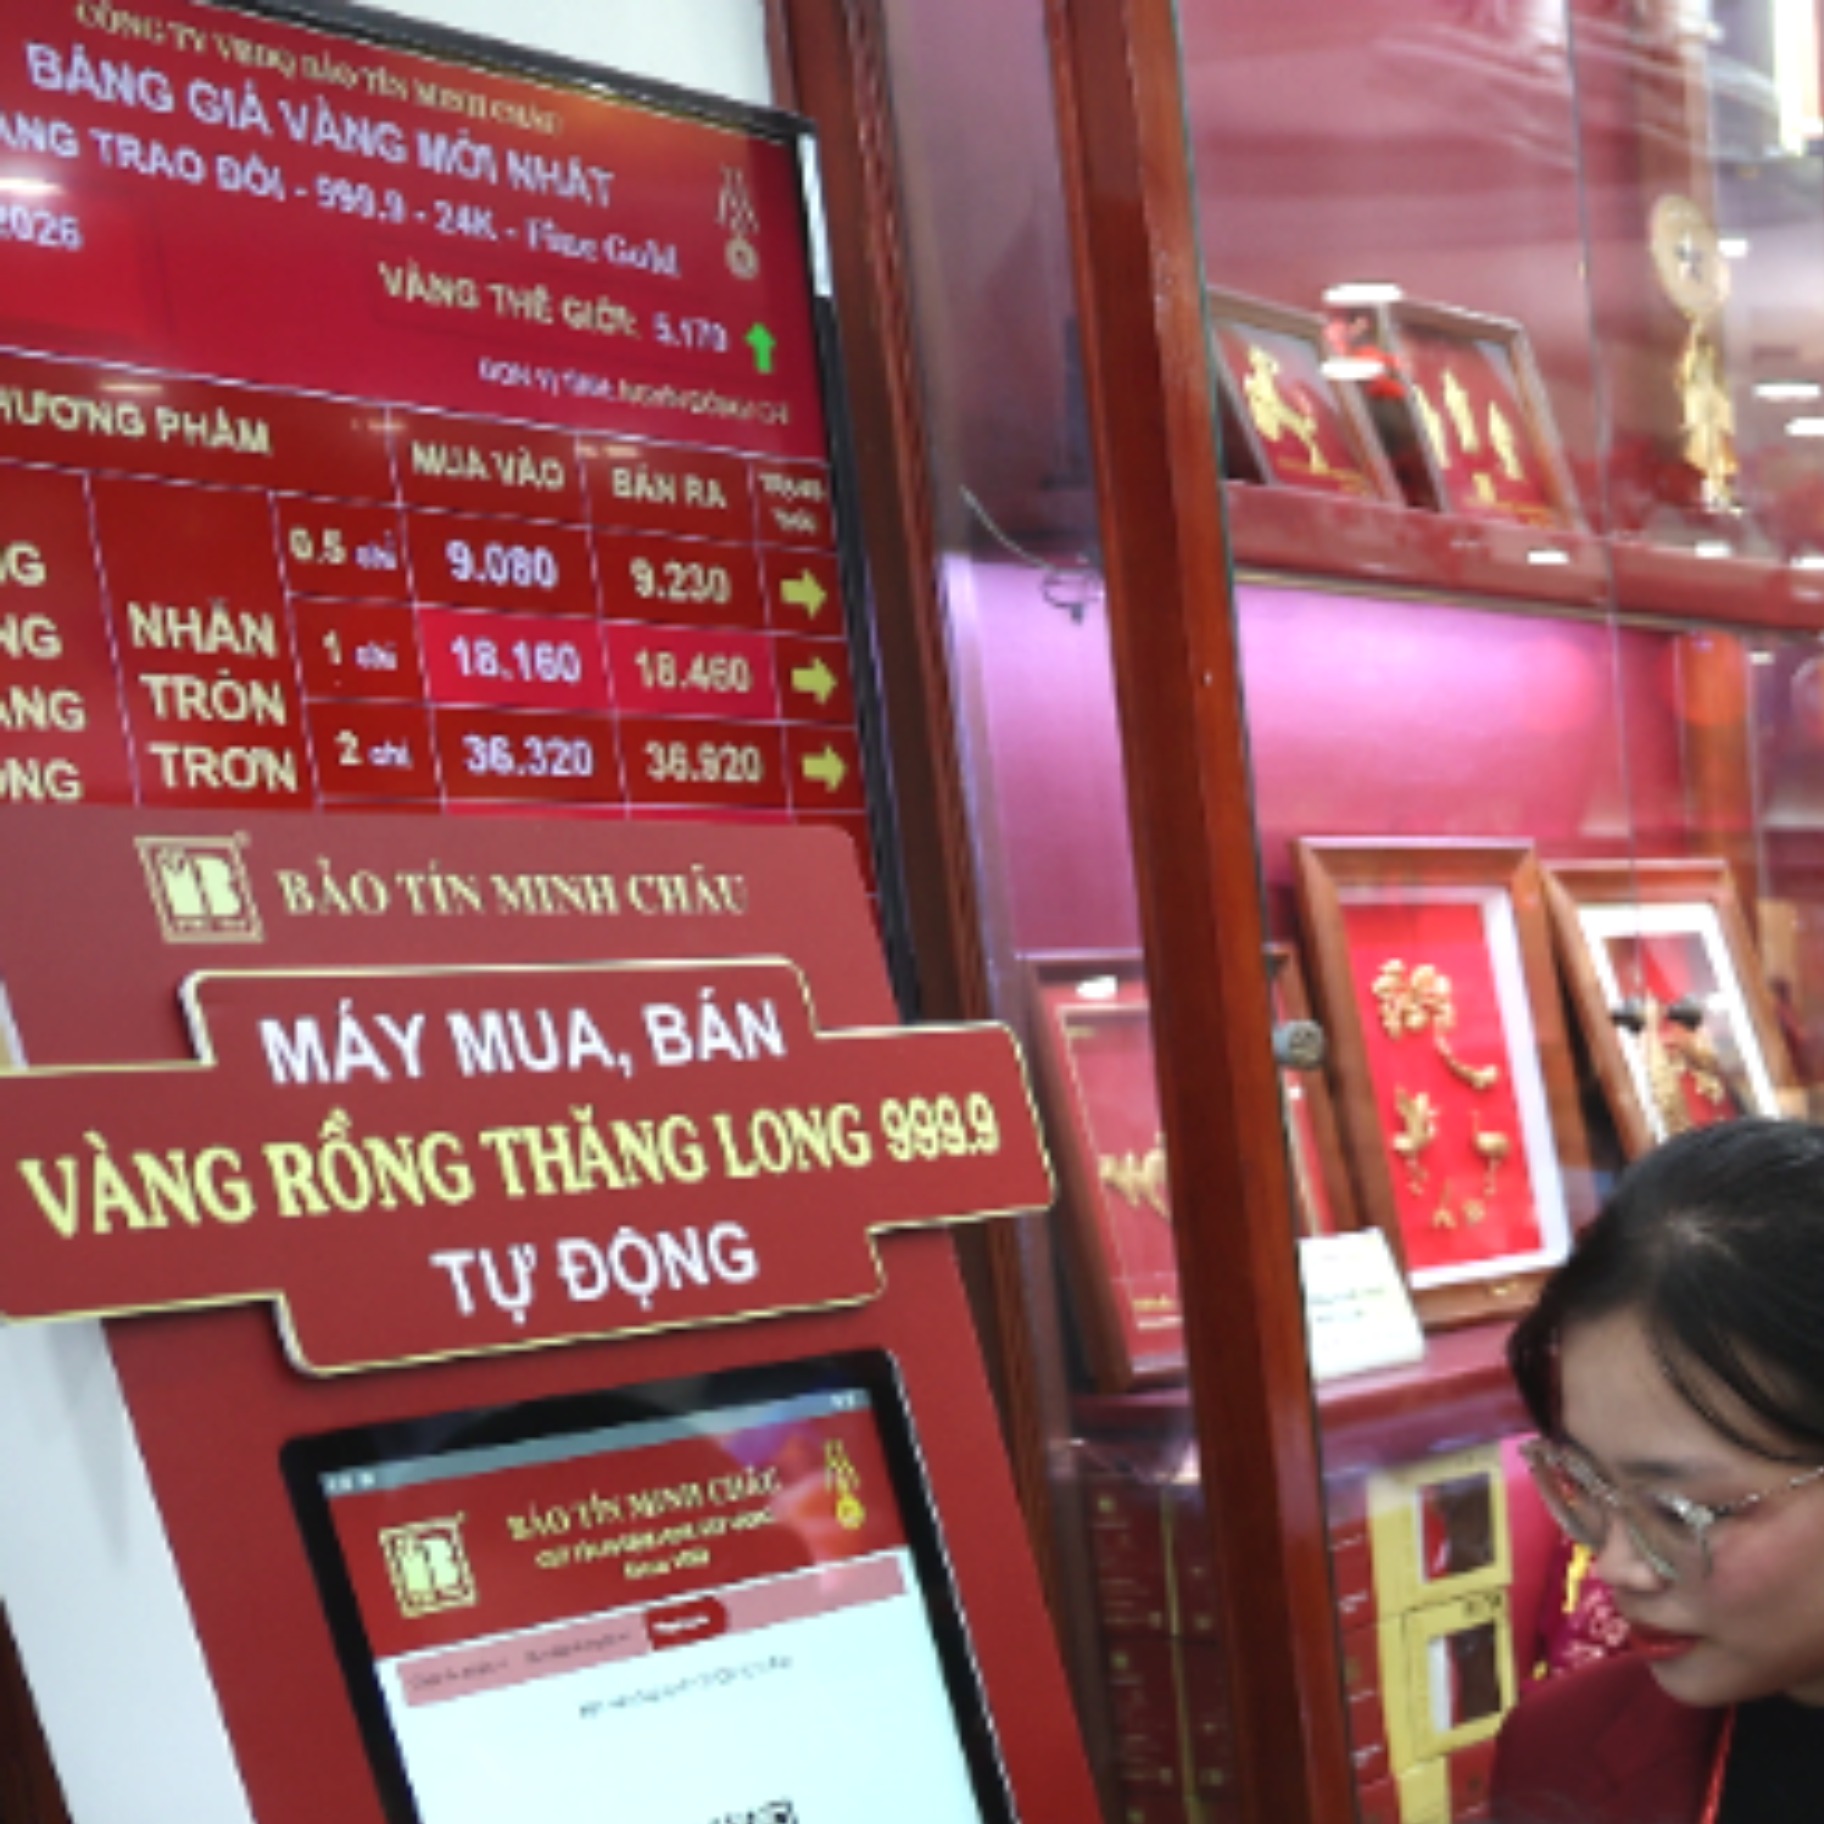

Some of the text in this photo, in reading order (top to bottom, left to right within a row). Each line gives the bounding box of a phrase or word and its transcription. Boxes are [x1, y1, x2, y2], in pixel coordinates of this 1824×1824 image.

[26, 40, 174, 114] BẢNG
[277, 94, 407, 164] VÀNG
[415, 127, 498, 185] MỚI
[89, 126, 206, 185] TRAO
[601, 232, 681, 278] Gold
[378, 257, 480, 310] VÀNG
[683, 474, 728, 510] RA
[445, 538, 558, 591] 9.080
[321, 628, 343, 666] 1
[449, 633, 582, 684] 18.160
[0, 756, 83, 803] NG
[335, 729, 363, 767] 2
[461, 733, 595, 778] 36.320
[276, 855, 750, 917] BẢO TÍN MINH CHÂU
[258, 986, 788, 1086] MÁY MUA, BÁN
[17, 1092, 1001, 1239] VÀNG RỒNG THĂNG LONG 999.9
[429, 1220, 759, 1326] TỰ ĐỘNG
